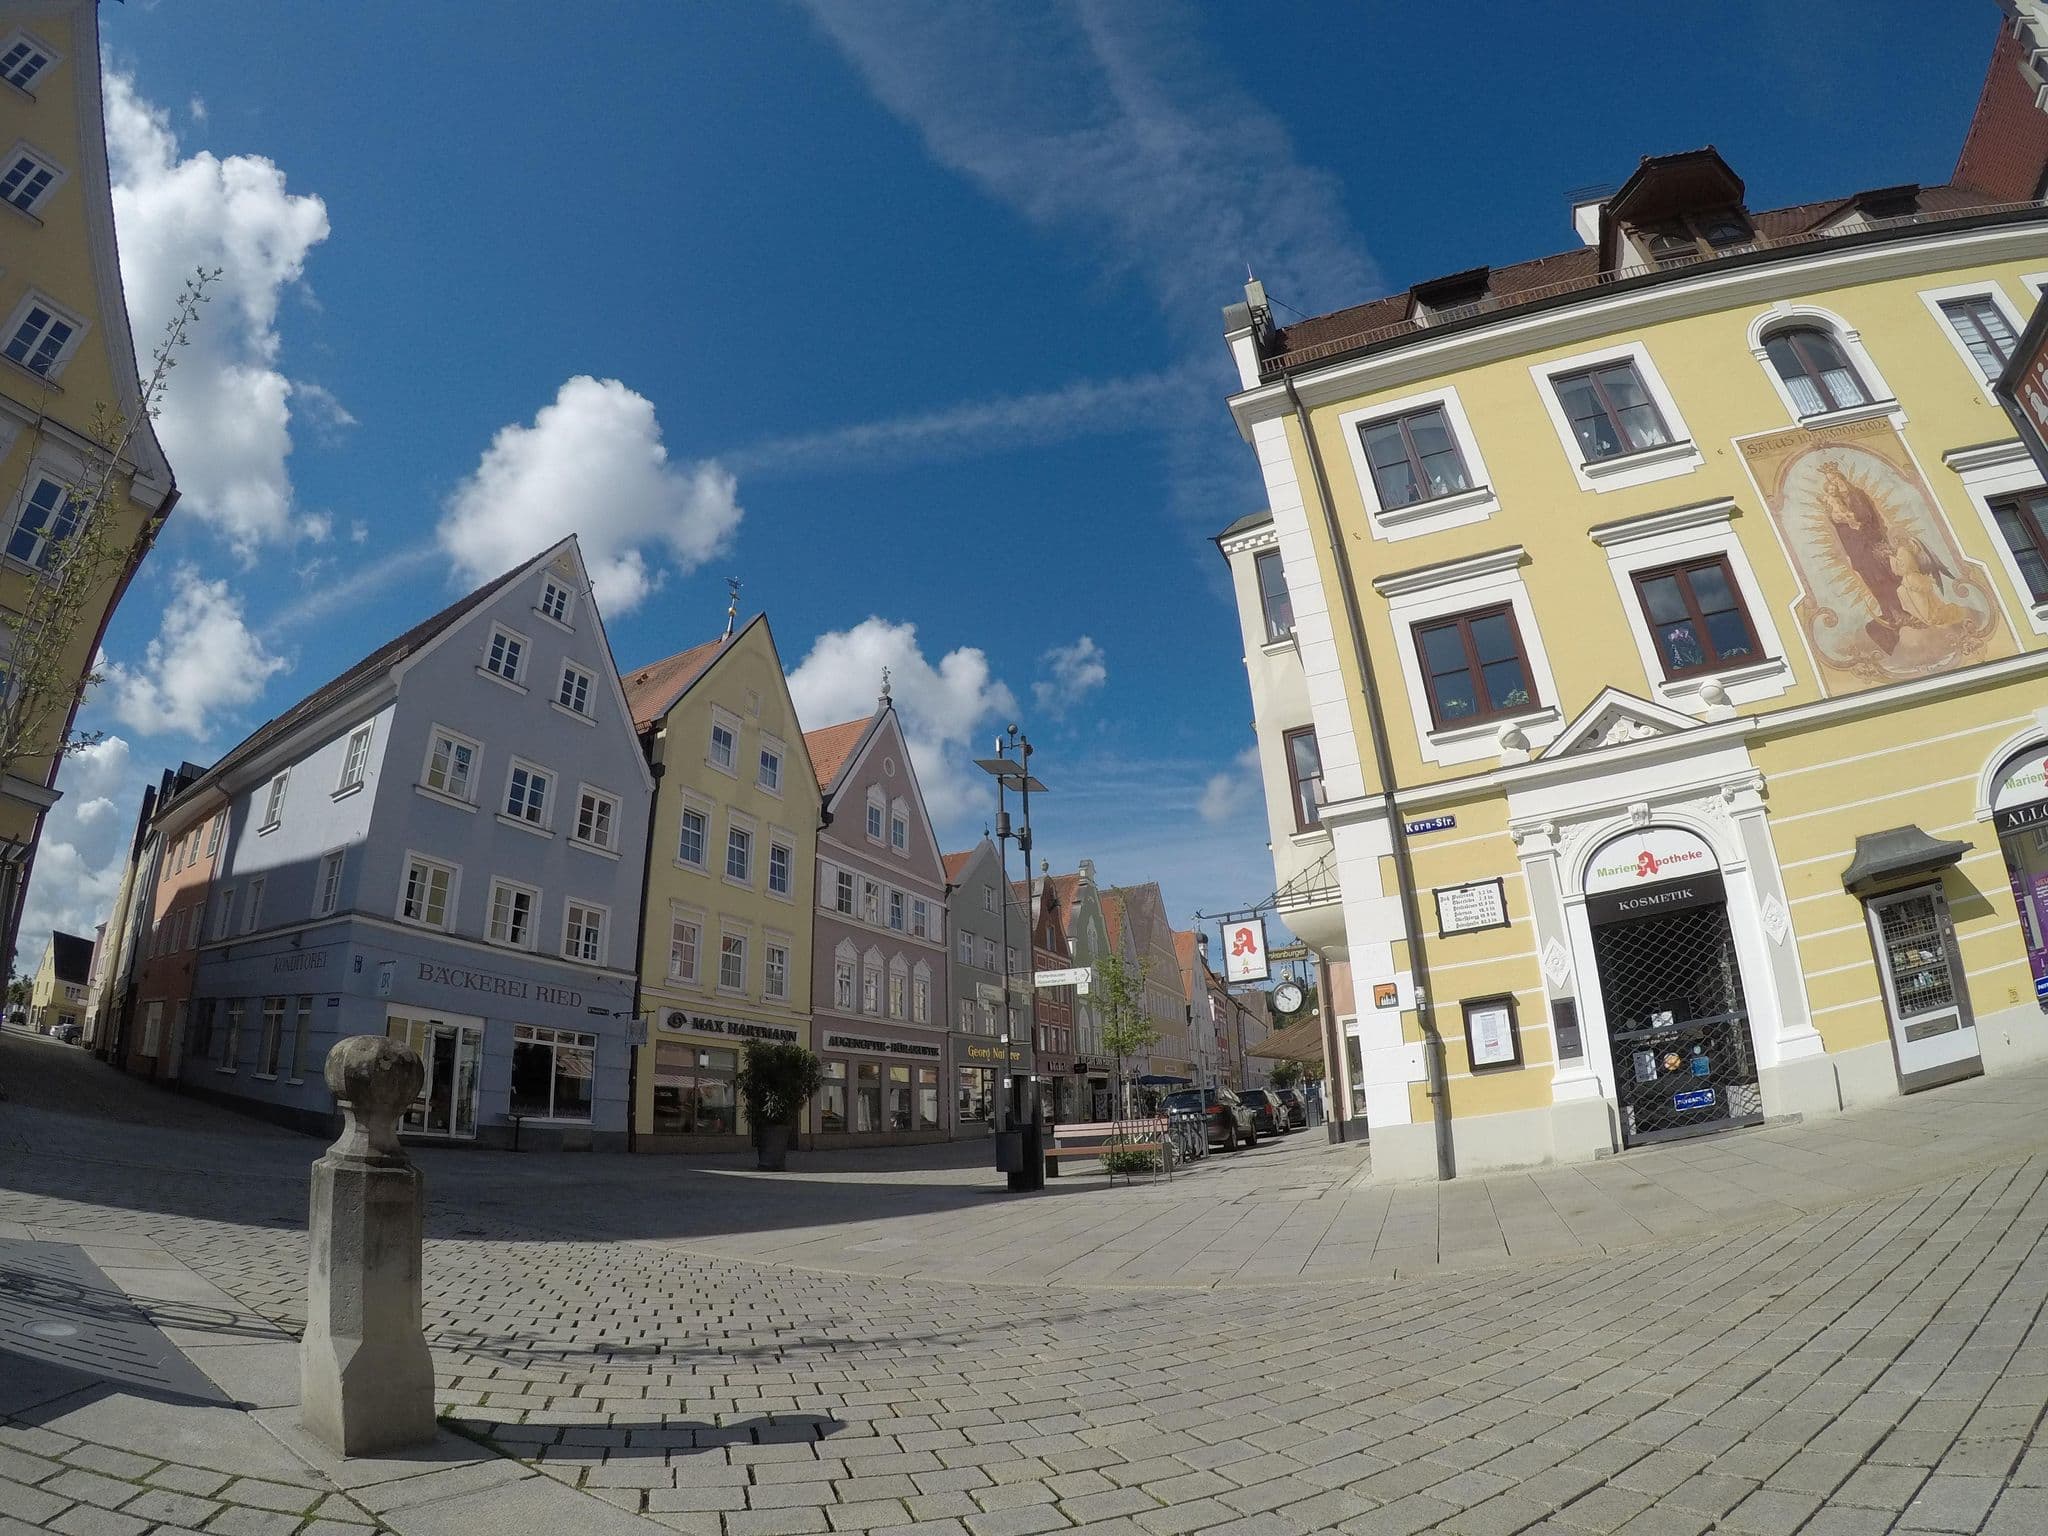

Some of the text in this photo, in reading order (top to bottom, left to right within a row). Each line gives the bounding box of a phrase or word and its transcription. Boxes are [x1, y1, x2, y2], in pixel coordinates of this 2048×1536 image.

[1405, 817, 1454, 833] Korn-Str.
[1597, 863, 1640, 878] Marien
[1618, 888, 1695, 911] KOSMETIK
[417, 962, 582, 1008] BÄCKEREI RIED
[692, 1017, 798, 1042] MAX HARTMANN
[968, 1045, 991, 1061] Georg
